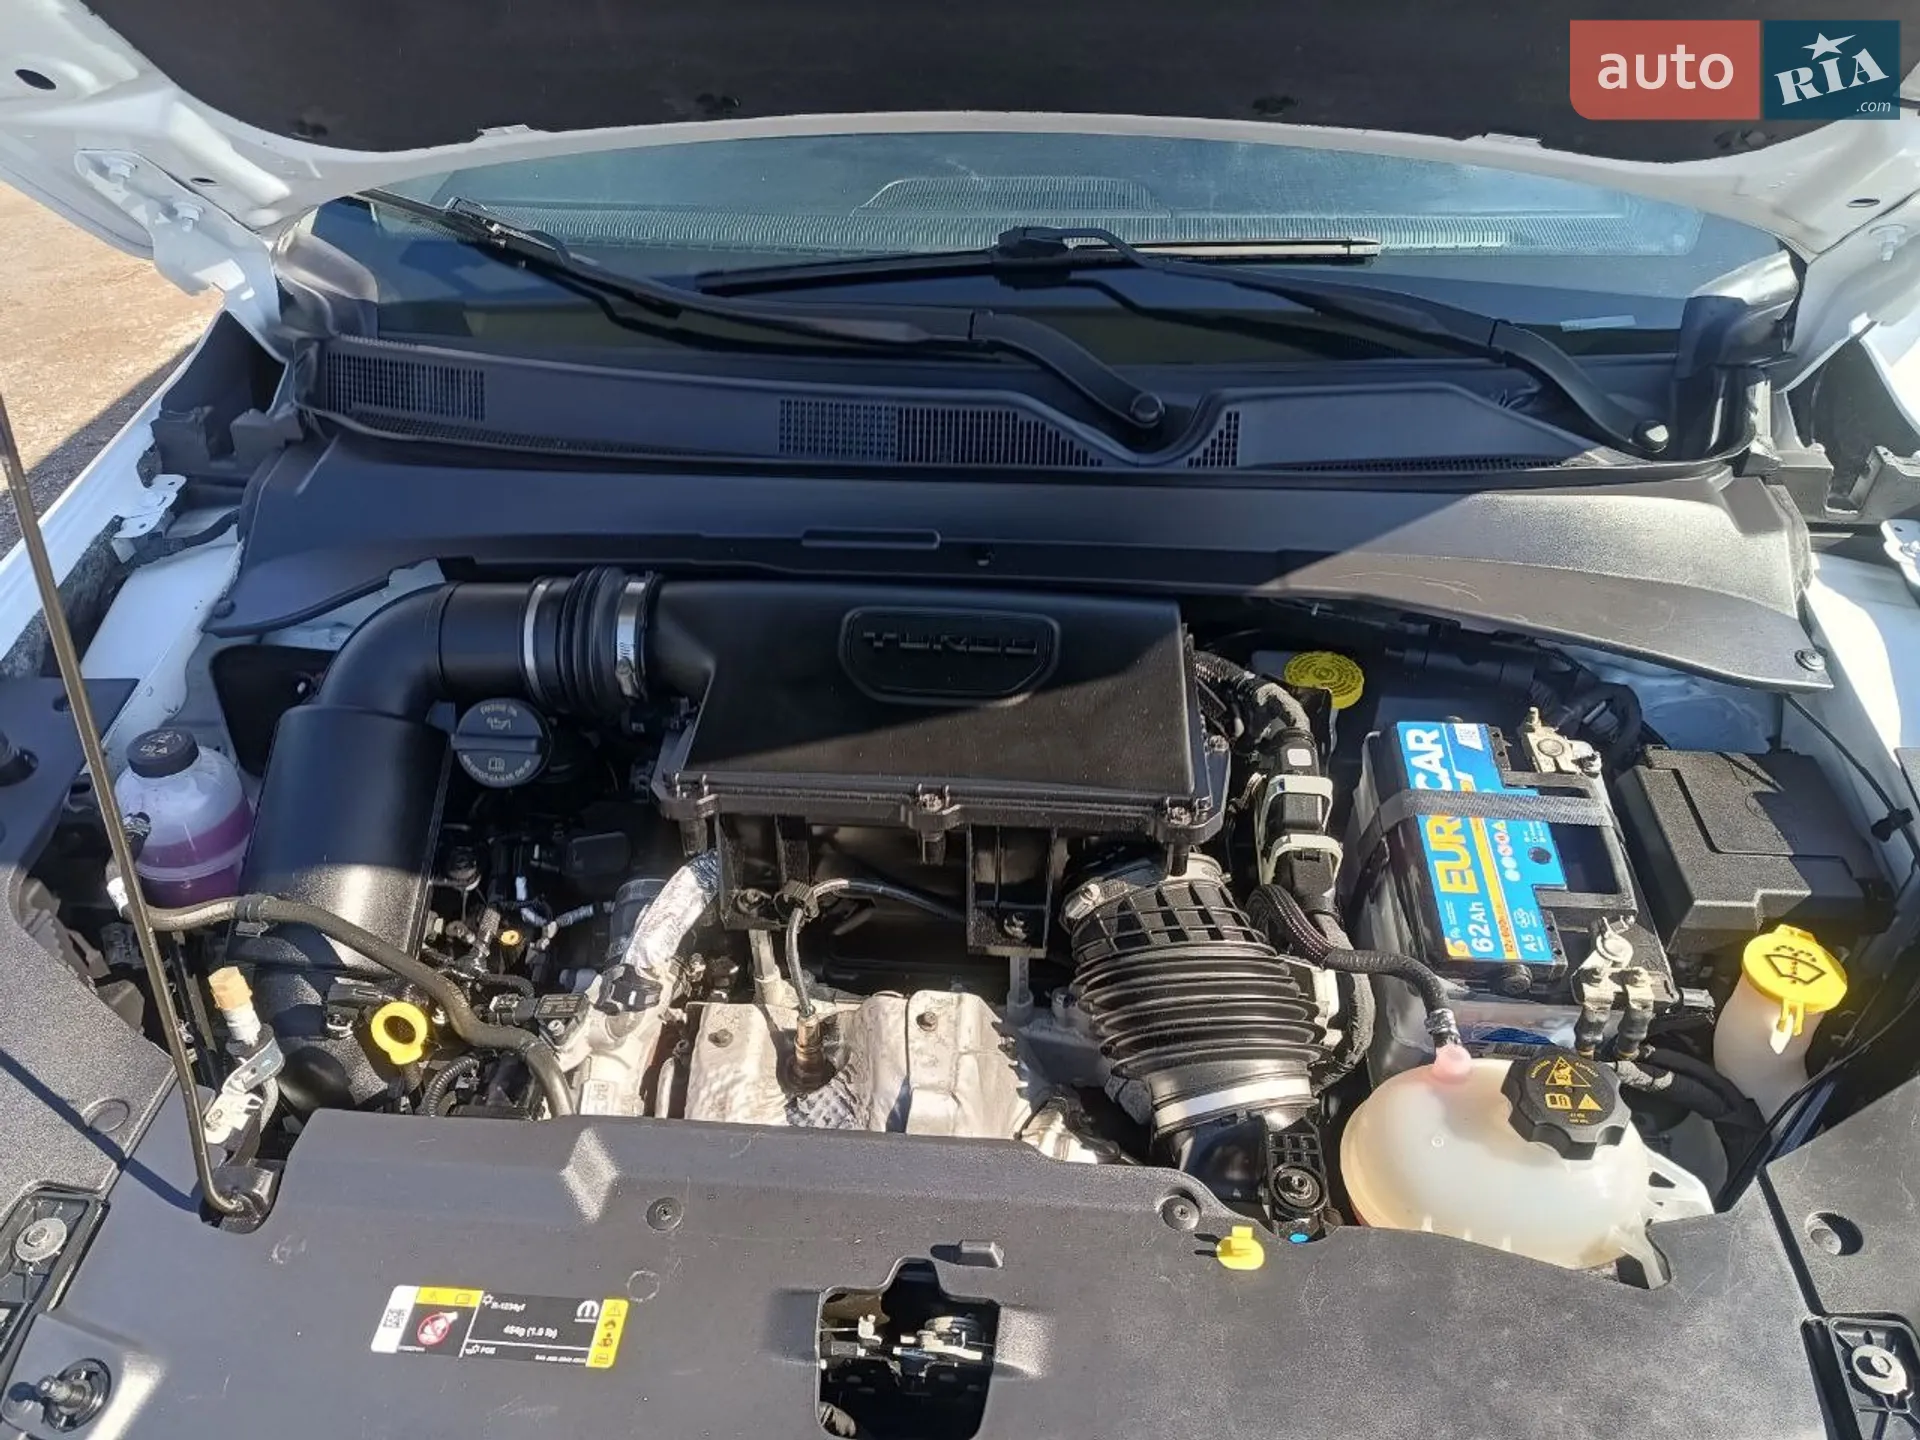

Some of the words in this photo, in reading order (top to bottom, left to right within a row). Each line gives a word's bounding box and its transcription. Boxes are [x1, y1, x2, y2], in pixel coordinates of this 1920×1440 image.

[863, 631, 1038, 655] TURBO
[1405, 729, 1479, 894] EURCAR
[1468, 901, 1494, 953] 62Ah
